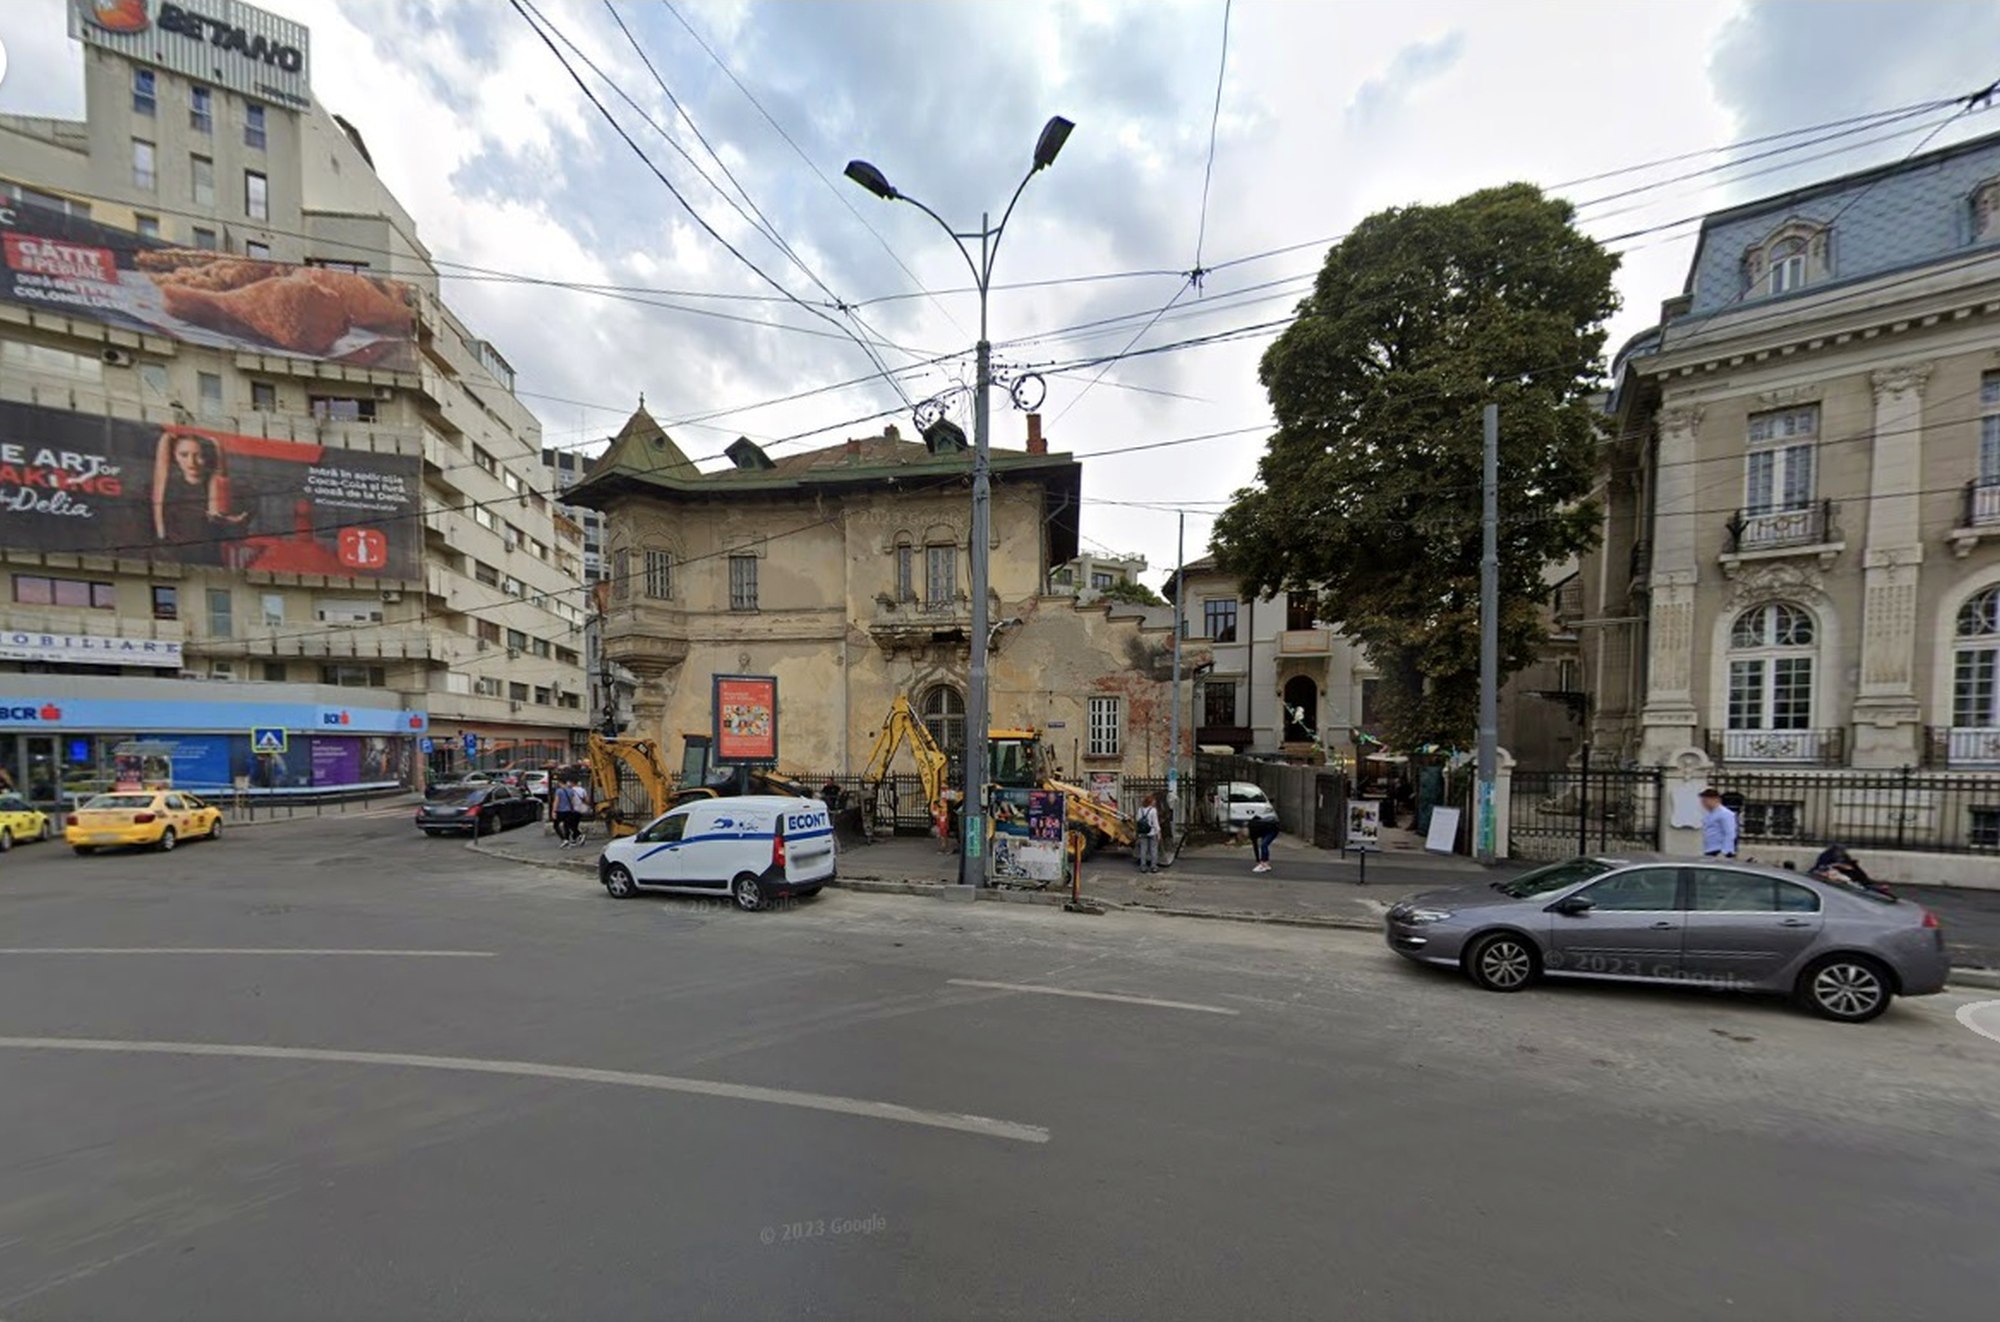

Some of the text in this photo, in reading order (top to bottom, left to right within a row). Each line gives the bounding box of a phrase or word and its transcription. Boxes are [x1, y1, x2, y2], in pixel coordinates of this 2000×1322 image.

[157, 1, 303, 73] BETANO
[33, 448, 107, 482] ART
[308, 475, 368, 490] Coca-Cola
[7, 486, 93, 518] Delia
[345, 489, 361, 498] de
[0, 634, 179, 653] OBILIARE
[0, 706, 37, 720] BCR
[788, 811, 827, 830] ECONT
